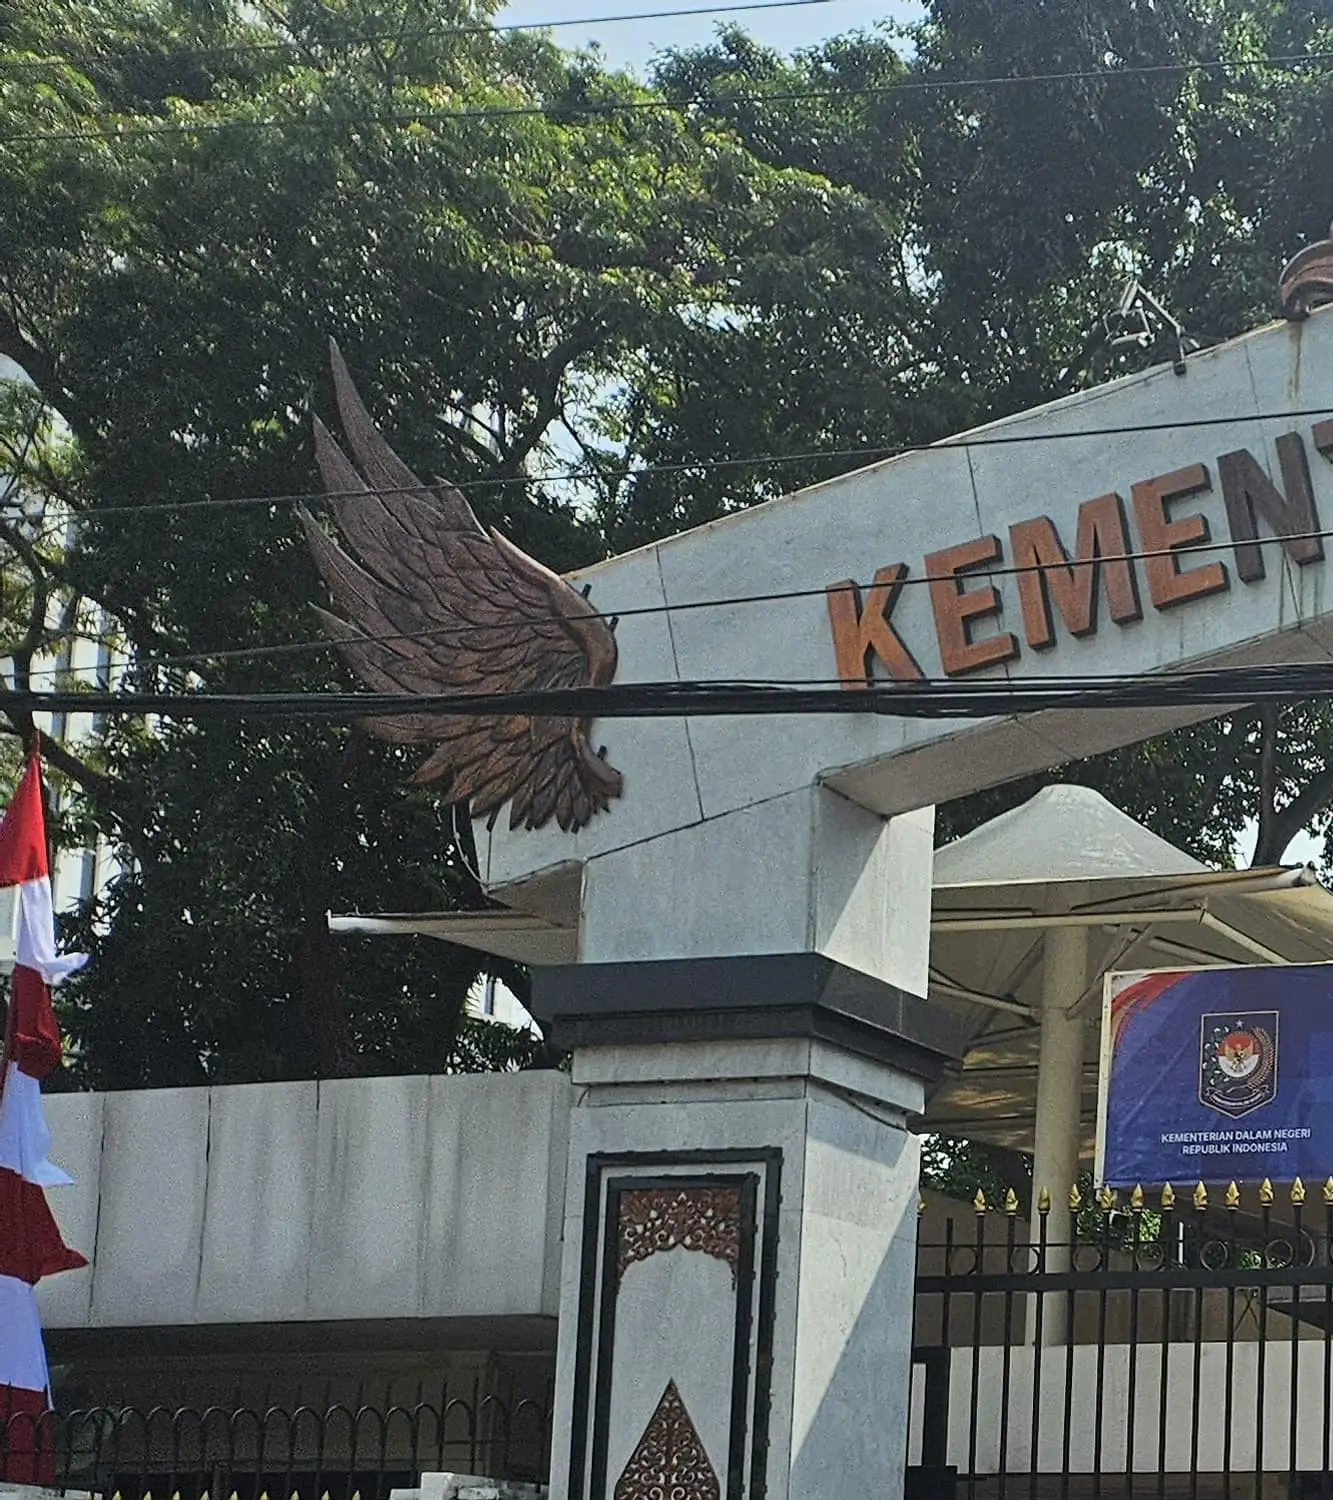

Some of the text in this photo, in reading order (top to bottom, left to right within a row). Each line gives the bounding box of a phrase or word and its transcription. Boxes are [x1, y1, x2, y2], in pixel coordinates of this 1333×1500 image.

[1161, 1128, 1311, 1144] KEMENTERIAN DALAM NEGERI
[1182, 1142, 1288, 1155] REPUBLIK INDONESIA
